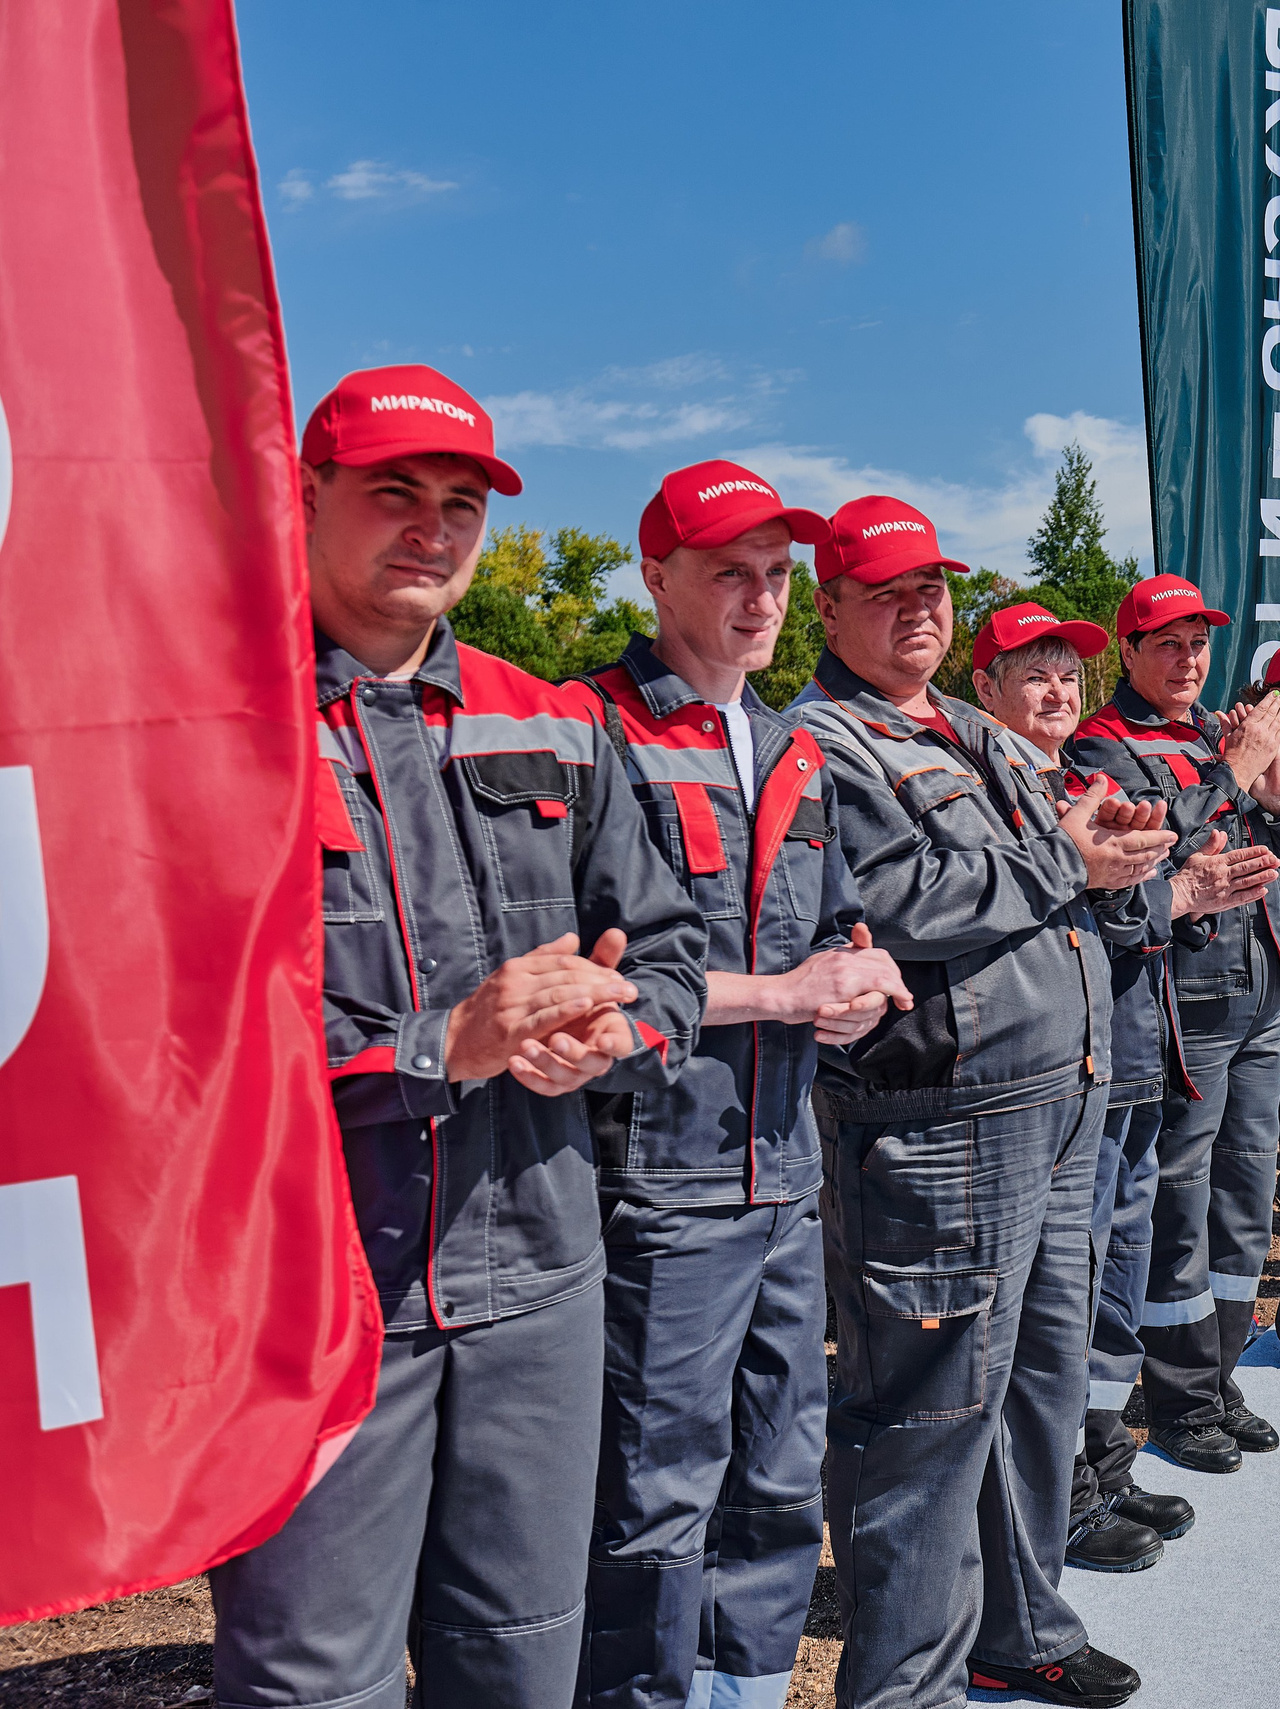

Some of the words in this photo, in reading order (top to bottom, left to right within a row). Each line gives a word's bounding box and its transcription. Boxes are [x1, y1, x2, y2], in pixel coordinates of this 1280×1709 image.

[371, 394, 476, 428] МИРАТОРГ
[862, 520, 927, 540] МИРАТОРГ
[1151, 588, 1198, 603] МИРАТОРГ
